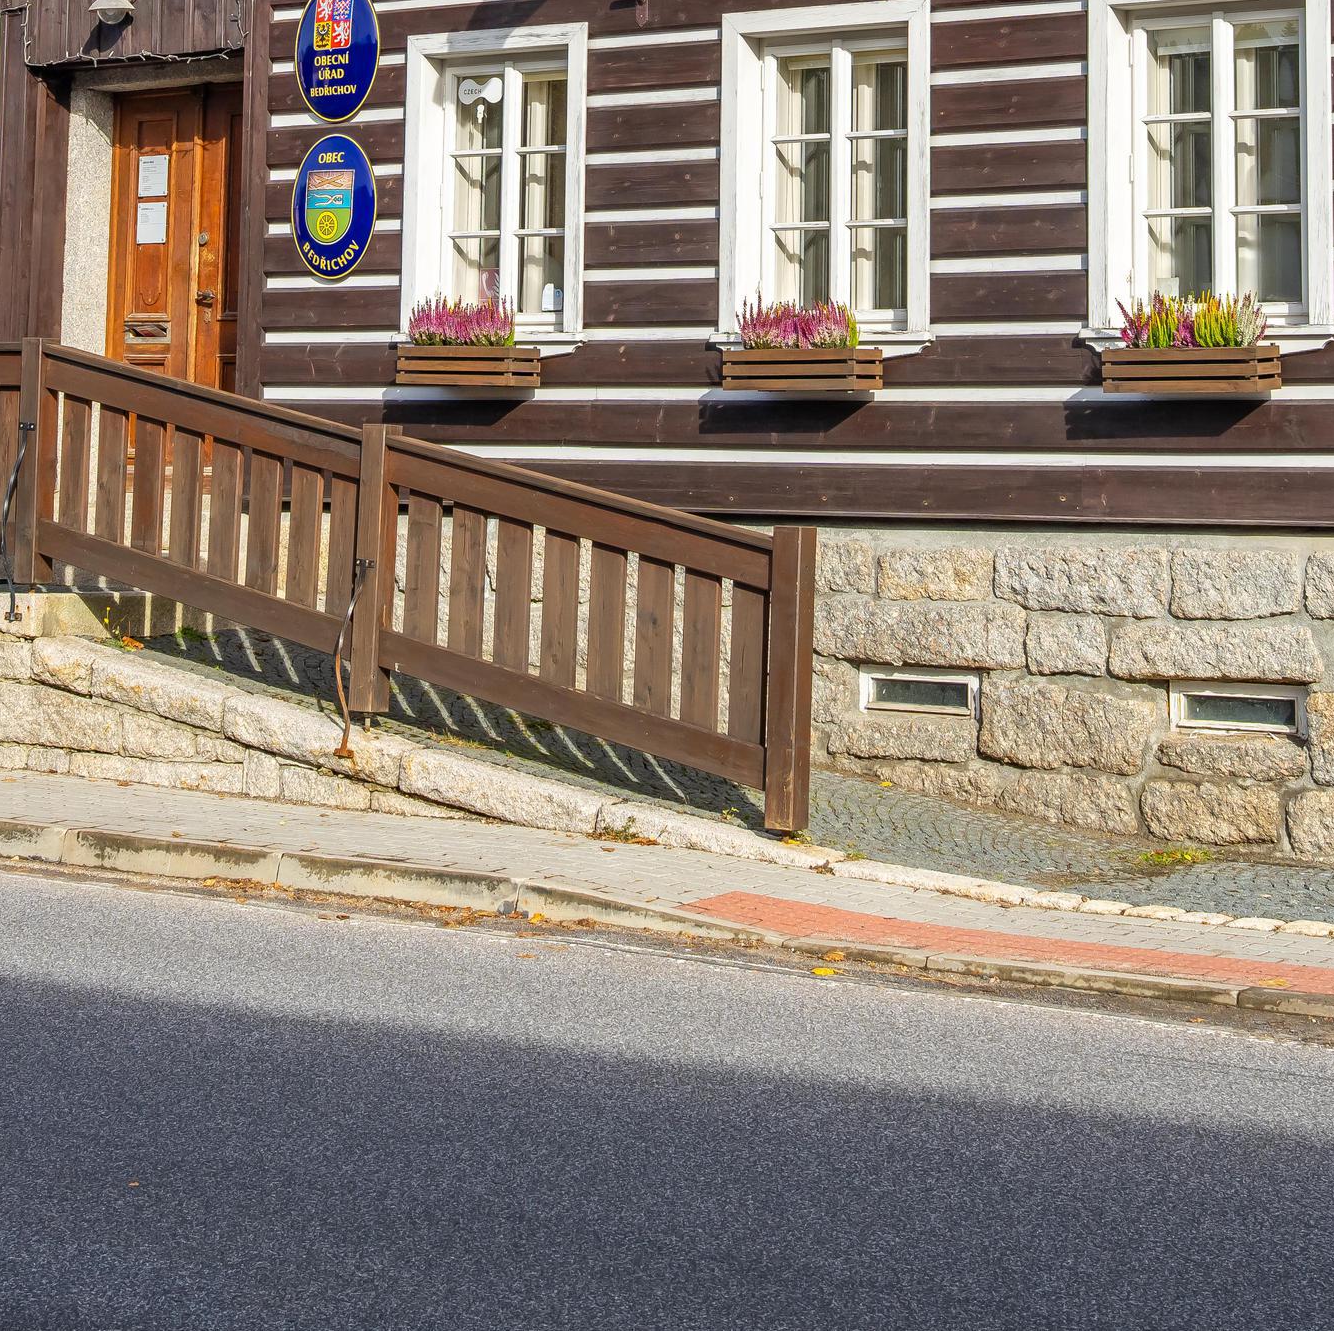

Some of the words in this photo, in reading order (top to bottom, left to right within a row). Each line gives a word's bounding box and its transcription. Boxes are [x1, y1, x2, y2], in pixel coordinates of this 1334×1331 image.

[314, 51, 349, 66] OBECNÍ
[318, 67, 345, 80] ÚŘAD
[310, 85, 357, 97] BEDŘICHOV
[318, 151, 345, 164] OBEC
[302, 239, 360, 271] BEDŘICHOV
